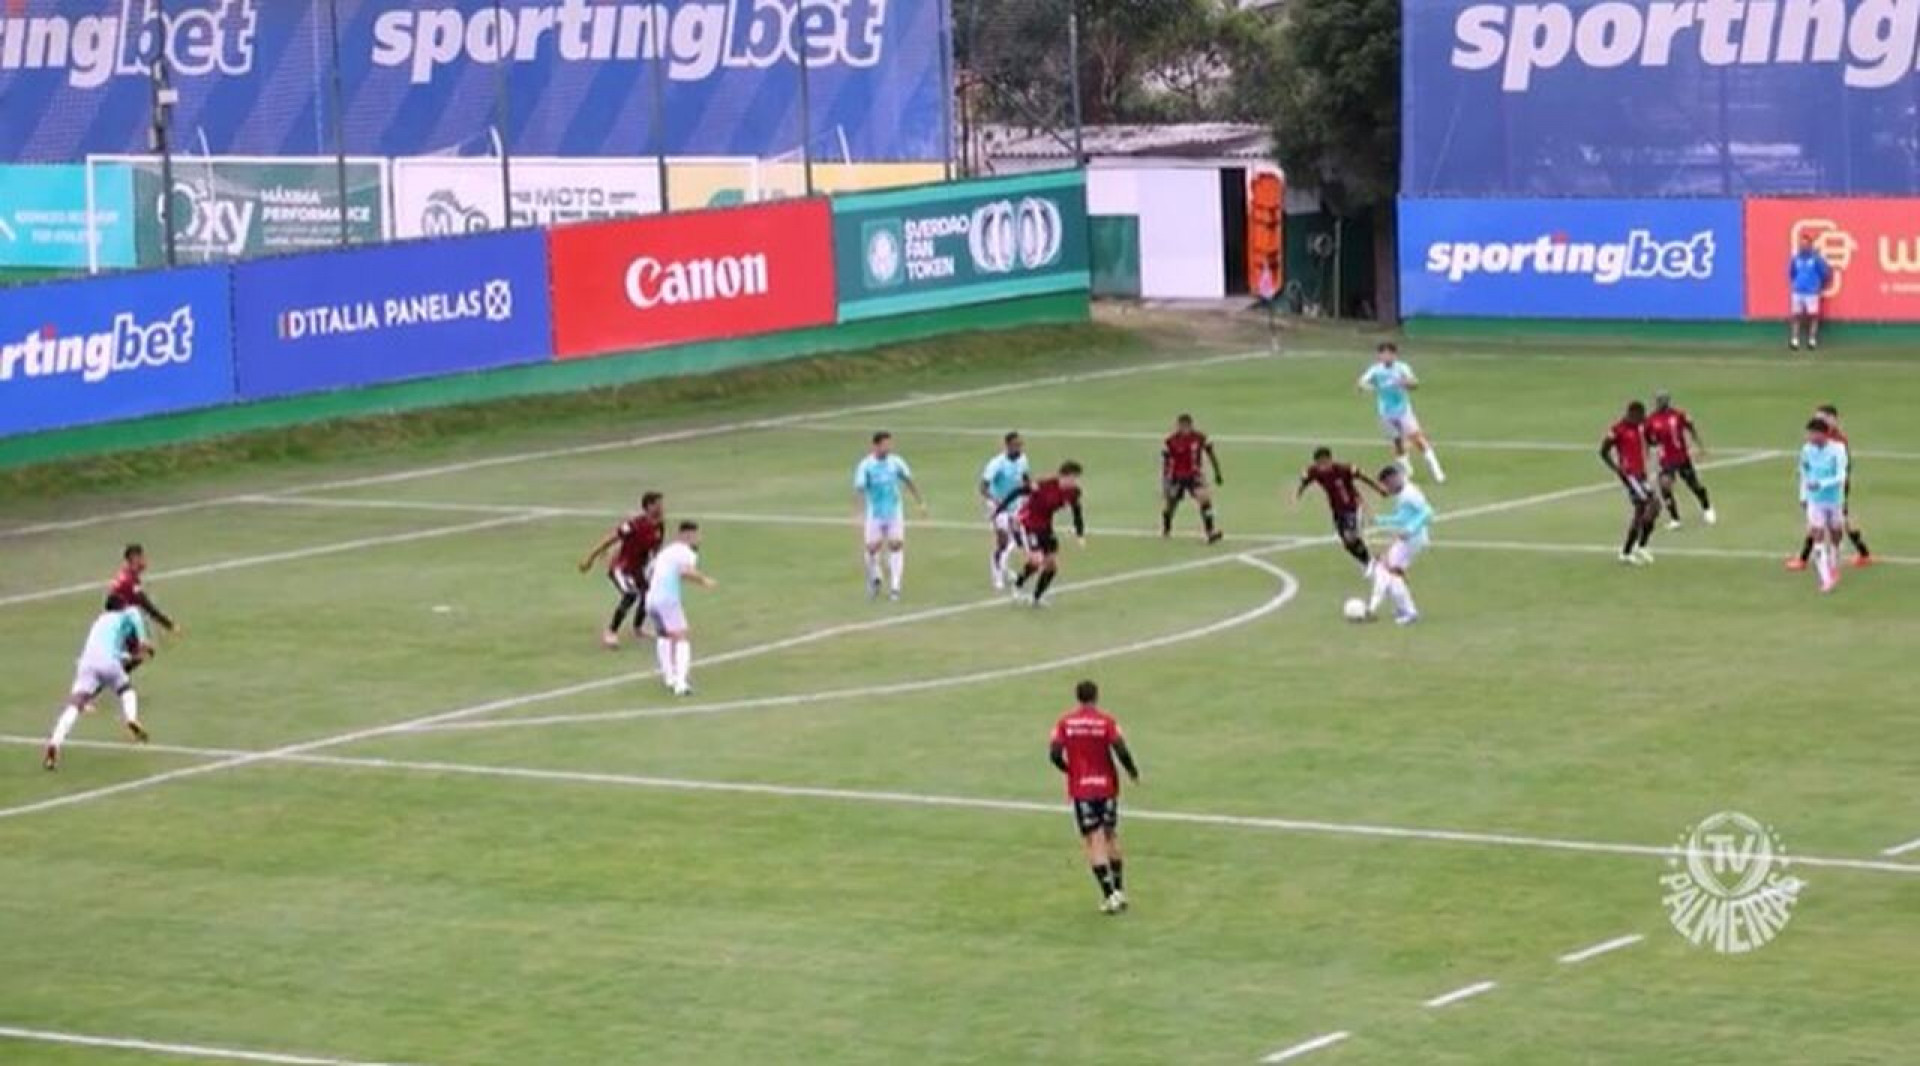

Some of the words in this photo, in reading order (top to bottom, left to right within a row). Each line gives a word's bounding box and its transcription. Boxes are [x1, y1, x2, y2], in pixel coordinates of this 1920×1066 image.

[0, 0, 256, 87] ingbet
[371, 0, 883, 84] sportingbet
[1452, 0, 1920, 91] sporting
[905, 239, 934, 260] FAN
[906, 255, 955, 281] TOKEN
[1426, 229, 1716, 283] sportingbet
[384, 289, 481, 326] PANELAS
[625, 251, 768, 309] Canon
